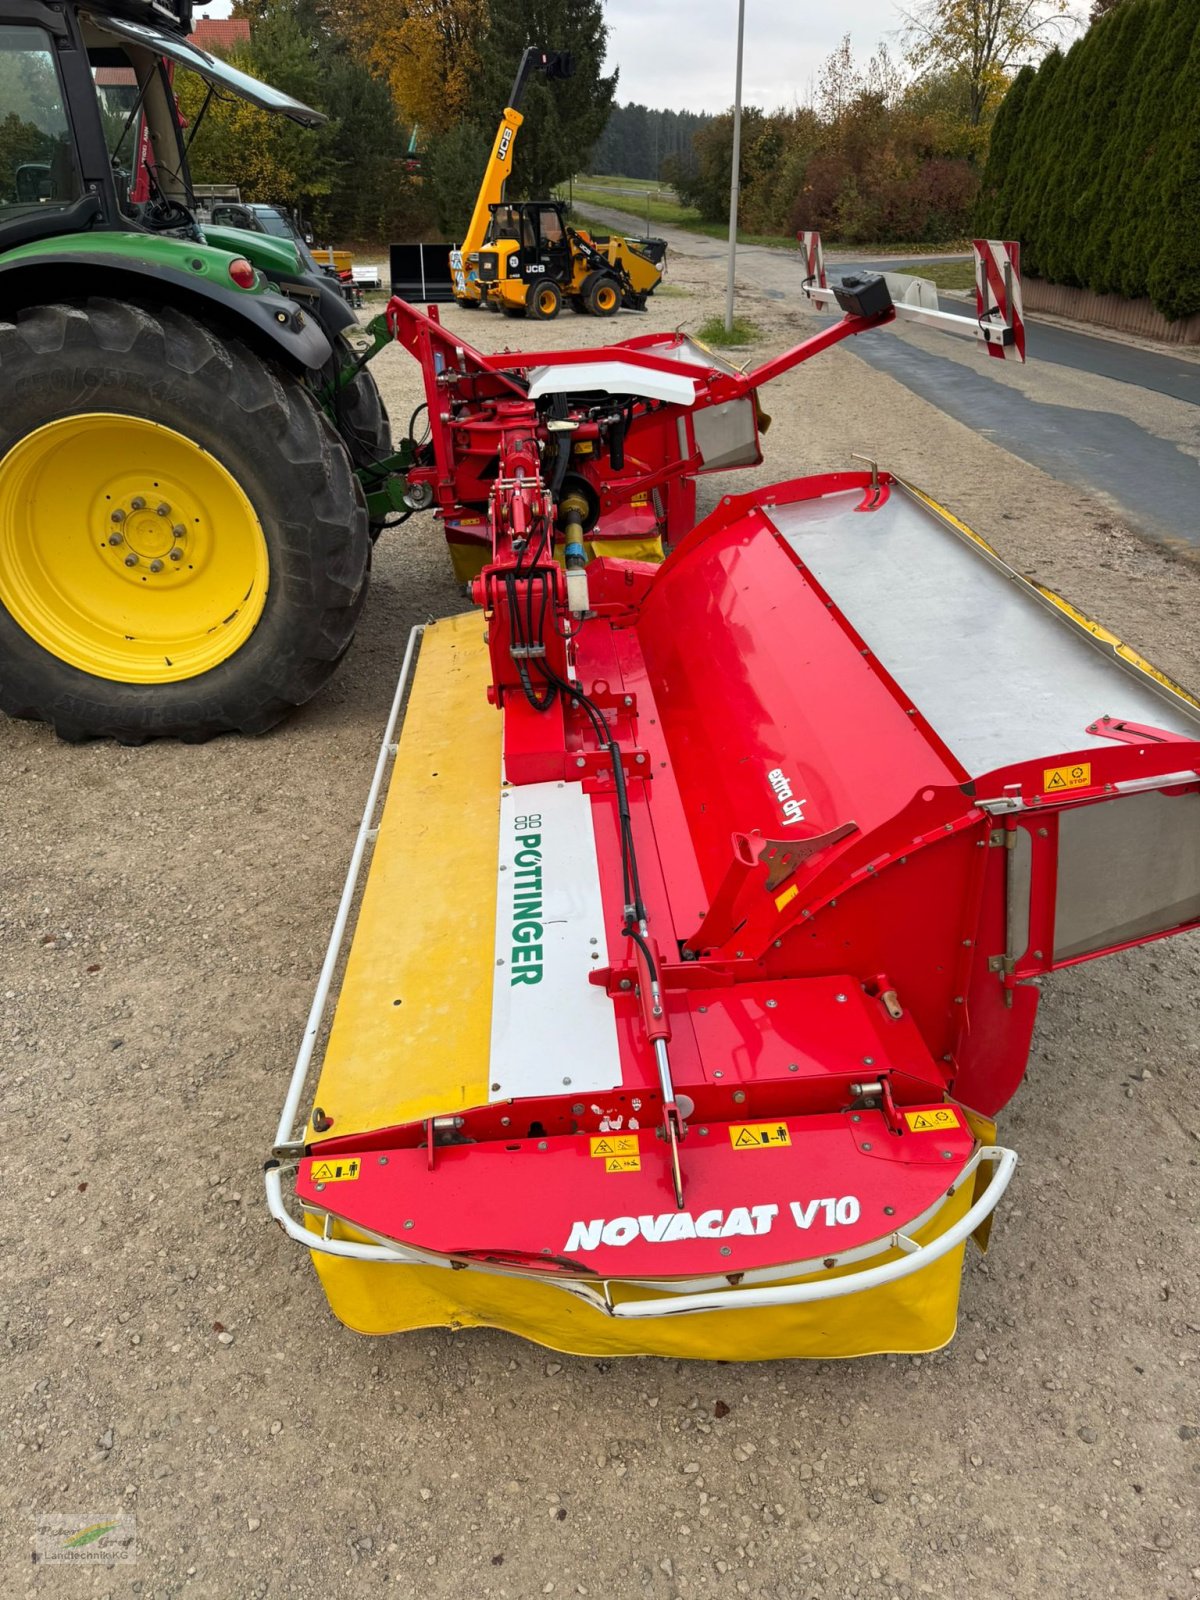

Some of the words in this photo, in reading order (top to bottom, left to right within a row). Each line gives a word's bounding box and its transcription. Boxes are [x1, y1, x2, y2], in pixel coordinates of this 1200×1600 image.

[498, 128, 512, 159] JCB
[579, 244, 591, 255] JCB
[525, 264, 546, 273] JCB
[767, 768, 803, 802] extra
[1069, 777, 1088, 785] STOP
[781, 798, 807, 826] dry
[563, 1203, 779, 1252] NOVACAT
[789, 1196, 861, 1229] V10
